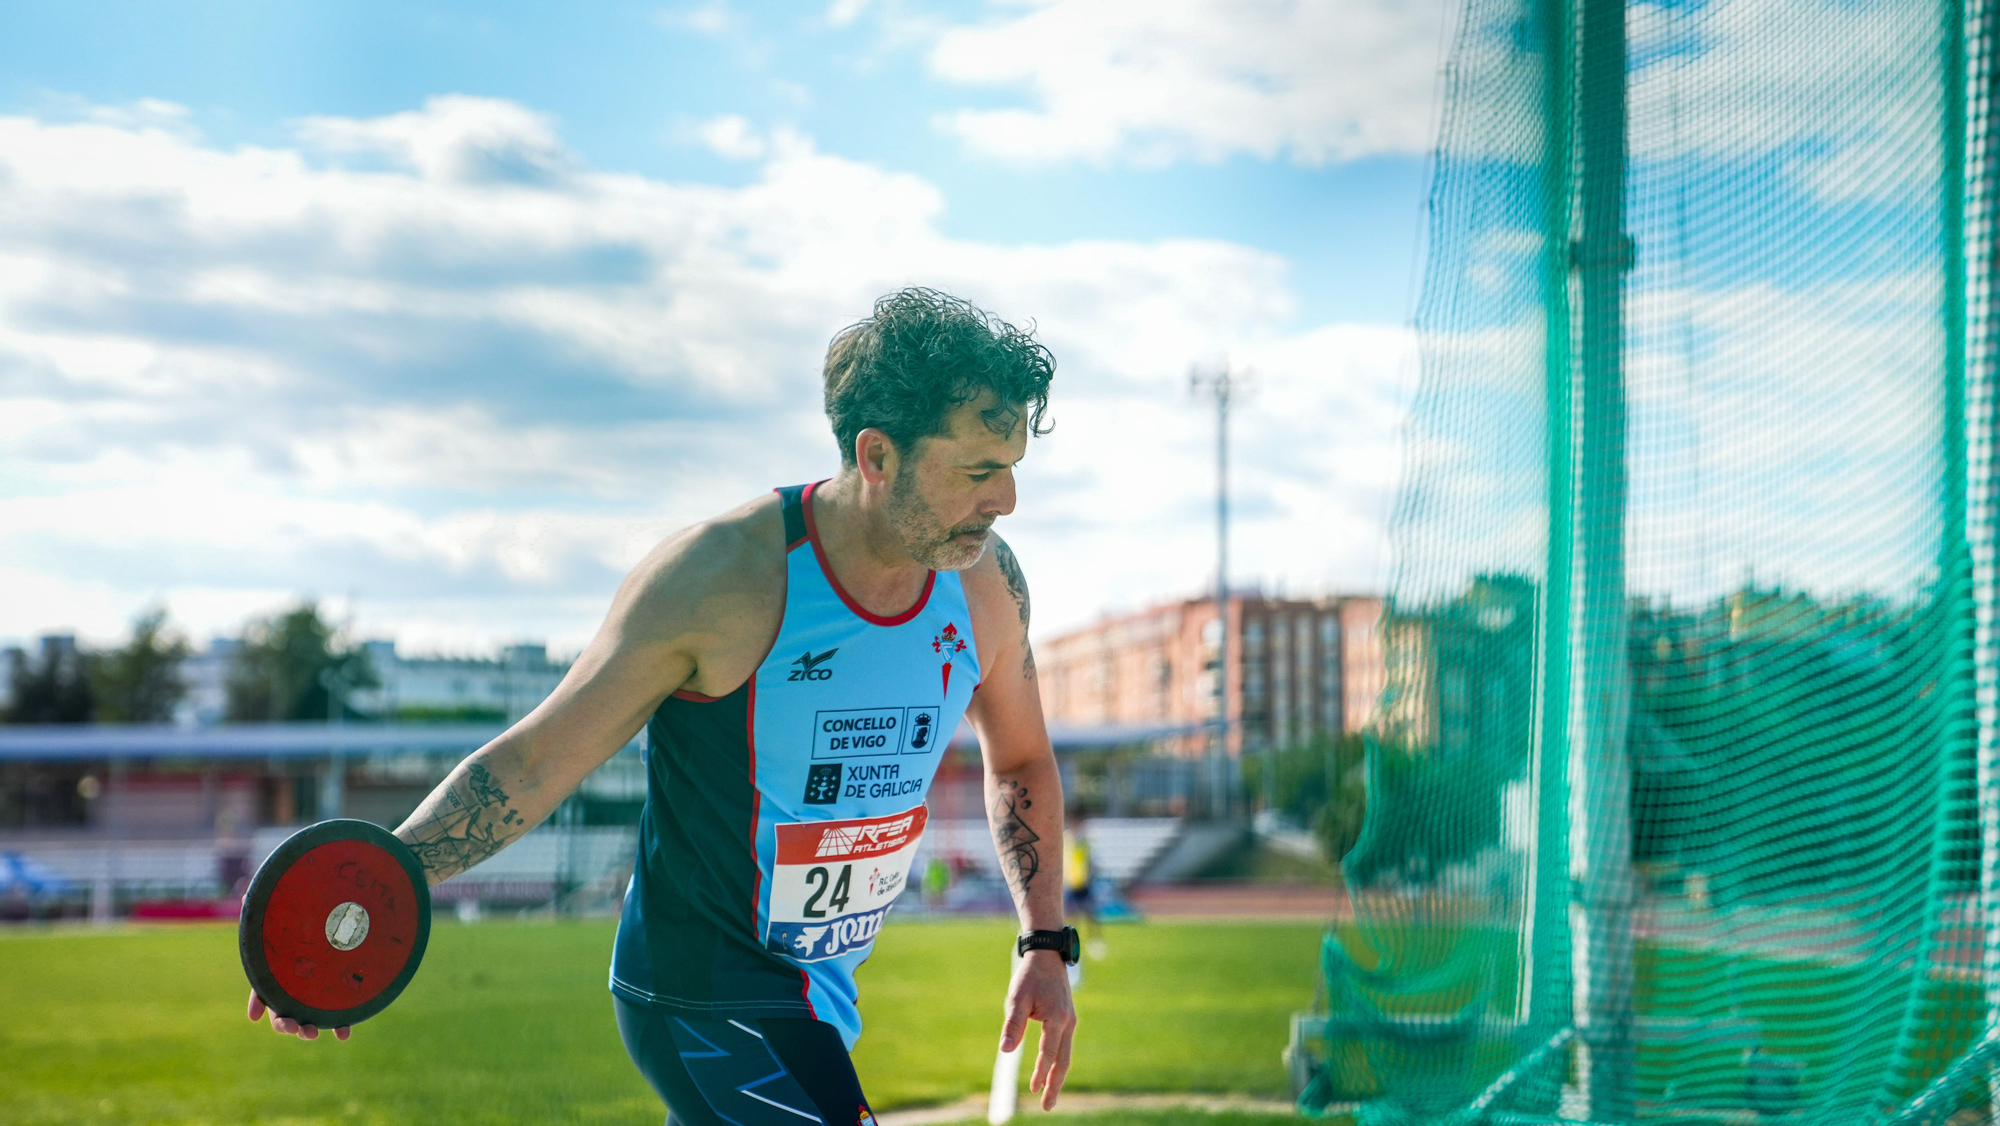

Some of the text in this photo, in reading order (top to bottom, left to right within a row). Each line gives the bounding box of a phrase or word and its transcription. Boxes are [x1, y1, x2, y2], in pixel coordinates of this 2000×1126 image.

[787, 669, 832, 681] ZICO
[823, 717, 896, 732] CONCELLO
[830, 735, 886, 750] DE VIGO
[847, 764, 900, 781] XUNTA
[844, 778, 923, 798] DE GALICIA
[857, 815, 914, 842] RFEA
[853, 835, 908, 854] ATLETISMO
[803, 864, 852, 918] 24
